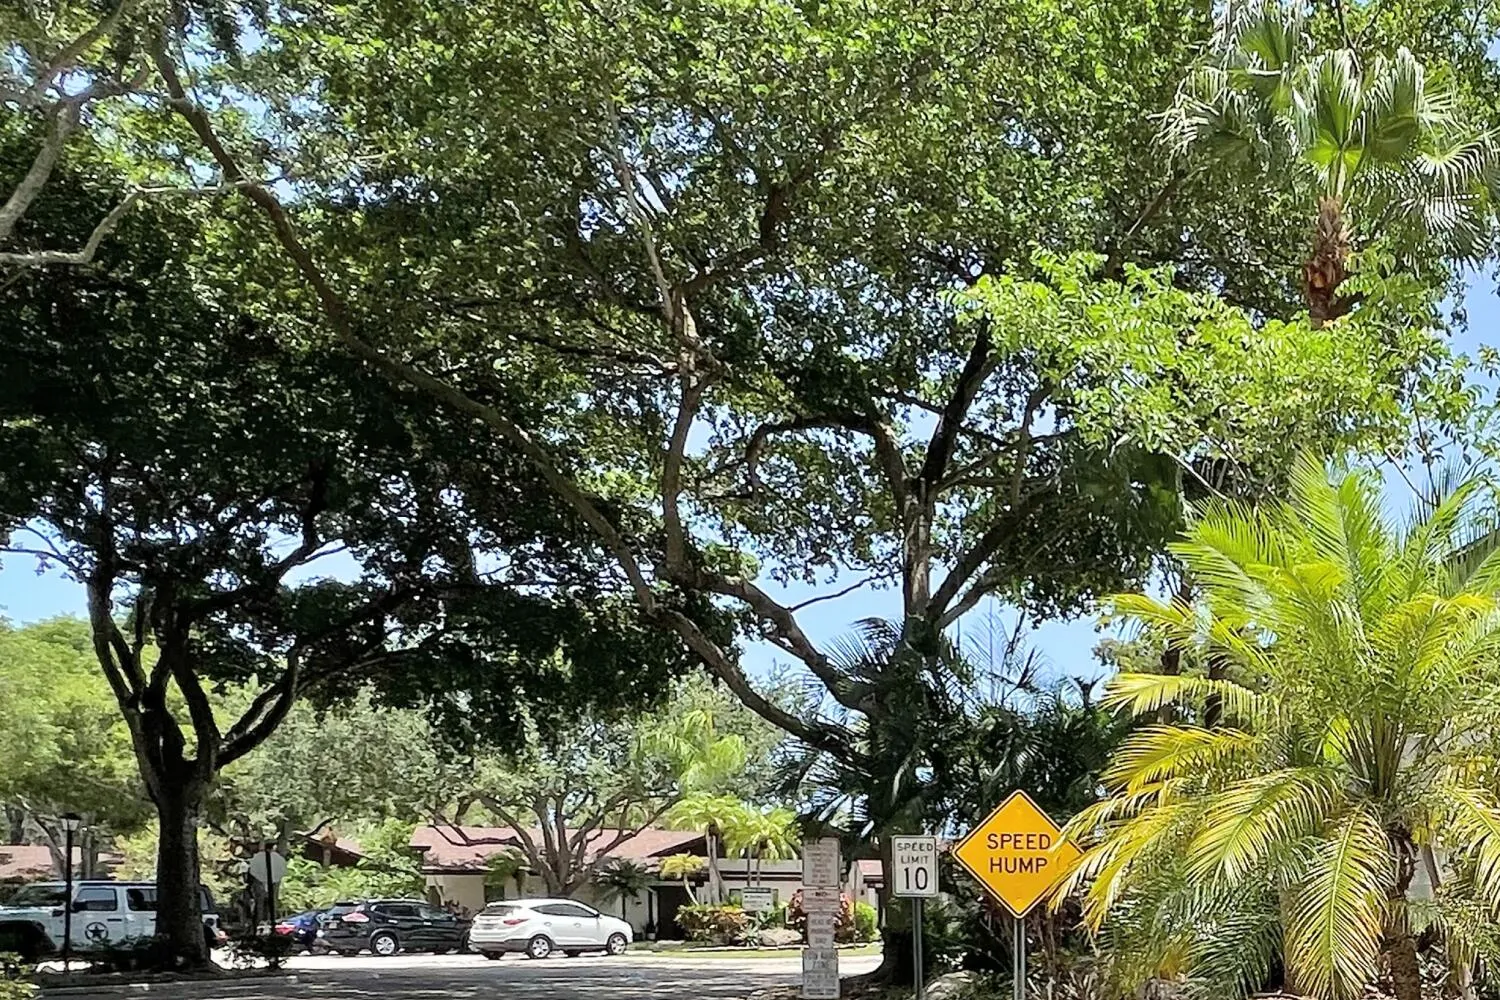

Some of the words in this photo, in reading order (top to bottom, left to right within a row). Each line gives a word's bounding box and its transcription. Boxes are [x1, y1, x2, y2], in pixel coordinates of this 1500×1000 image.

[897, 842, 933, 852] SPEED
[987, 834, 1051, 850] SPEED
[901, 856, 928, 864] LIMIT
[990, 858, 1047, 873] HUMP
[904, 867, 928, 890] 10
